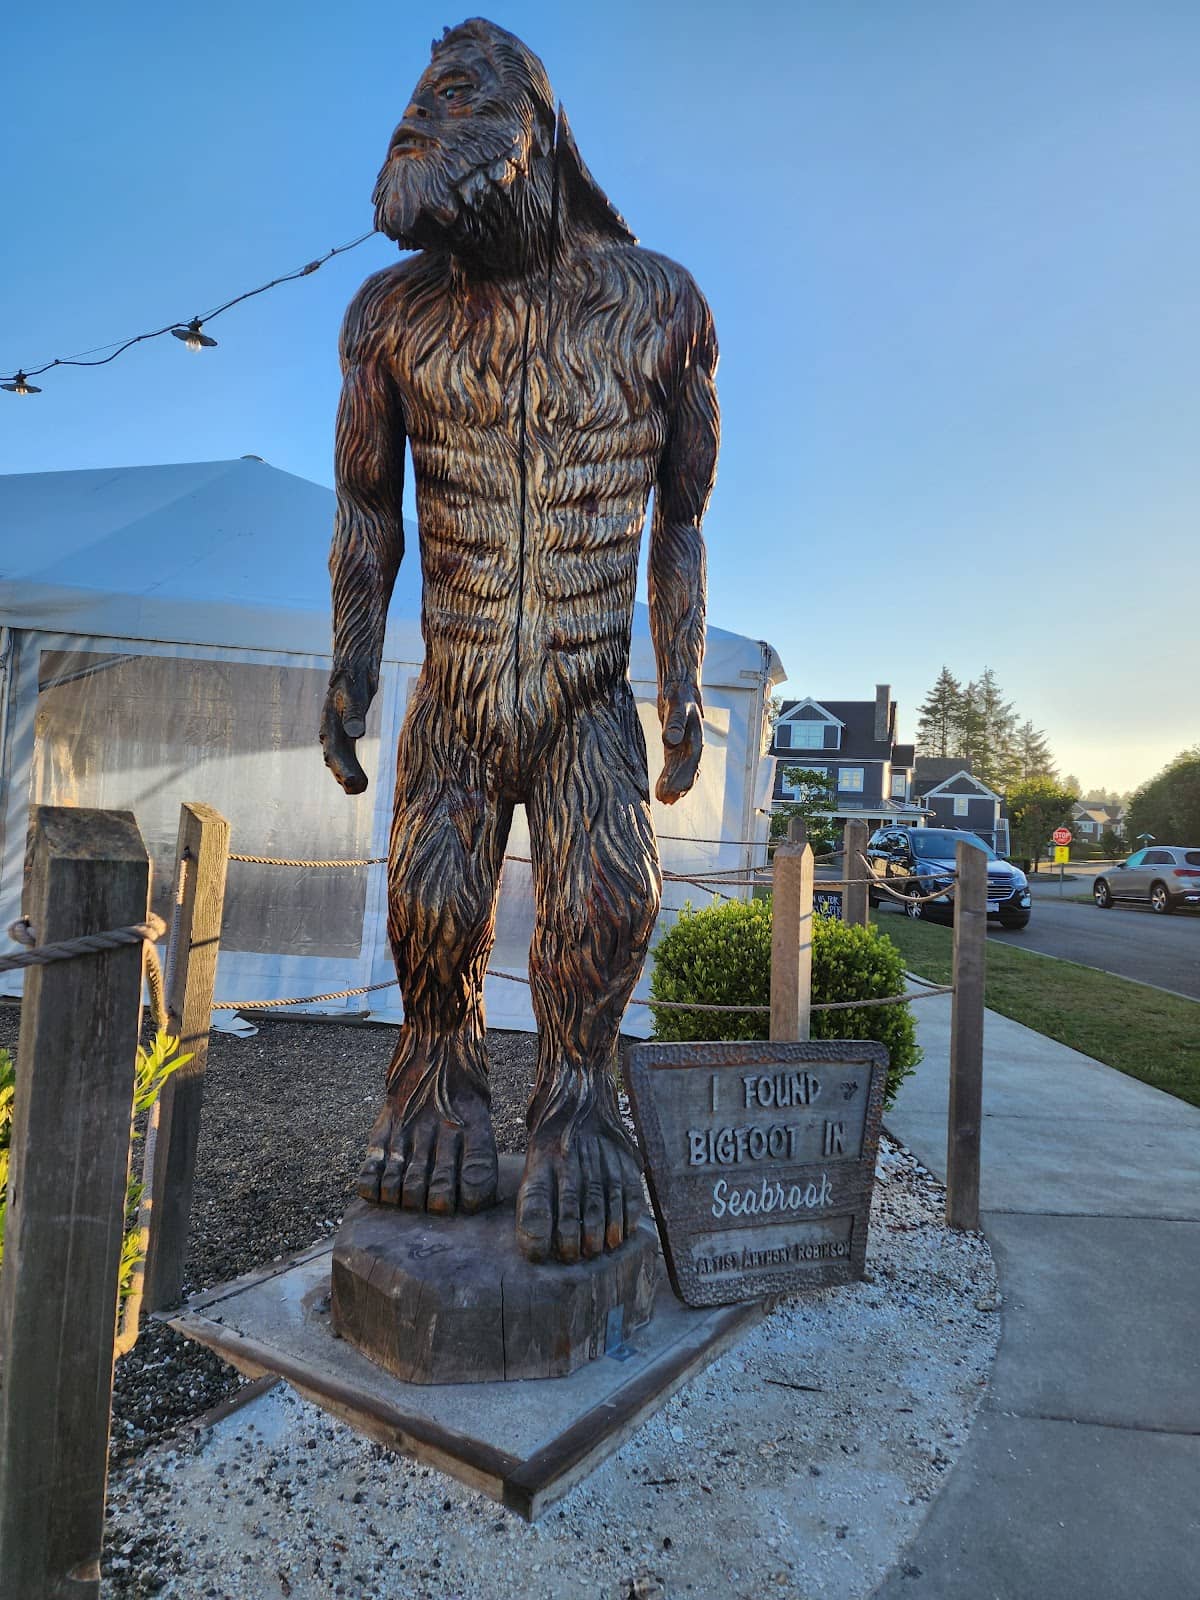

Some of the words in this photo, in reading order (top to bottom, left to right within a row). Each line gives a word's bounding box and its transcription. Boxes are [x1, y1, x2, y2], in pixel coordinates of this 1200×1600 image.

[711, 1074, 719, 1111] I
[742, 1072, 822, 1109] FOUND
[688, 1123, 798, 1166] BIGFOOT
[823, 1119, 847, 1156] IN
[711, 1173, 834, 1219] Seabrook
